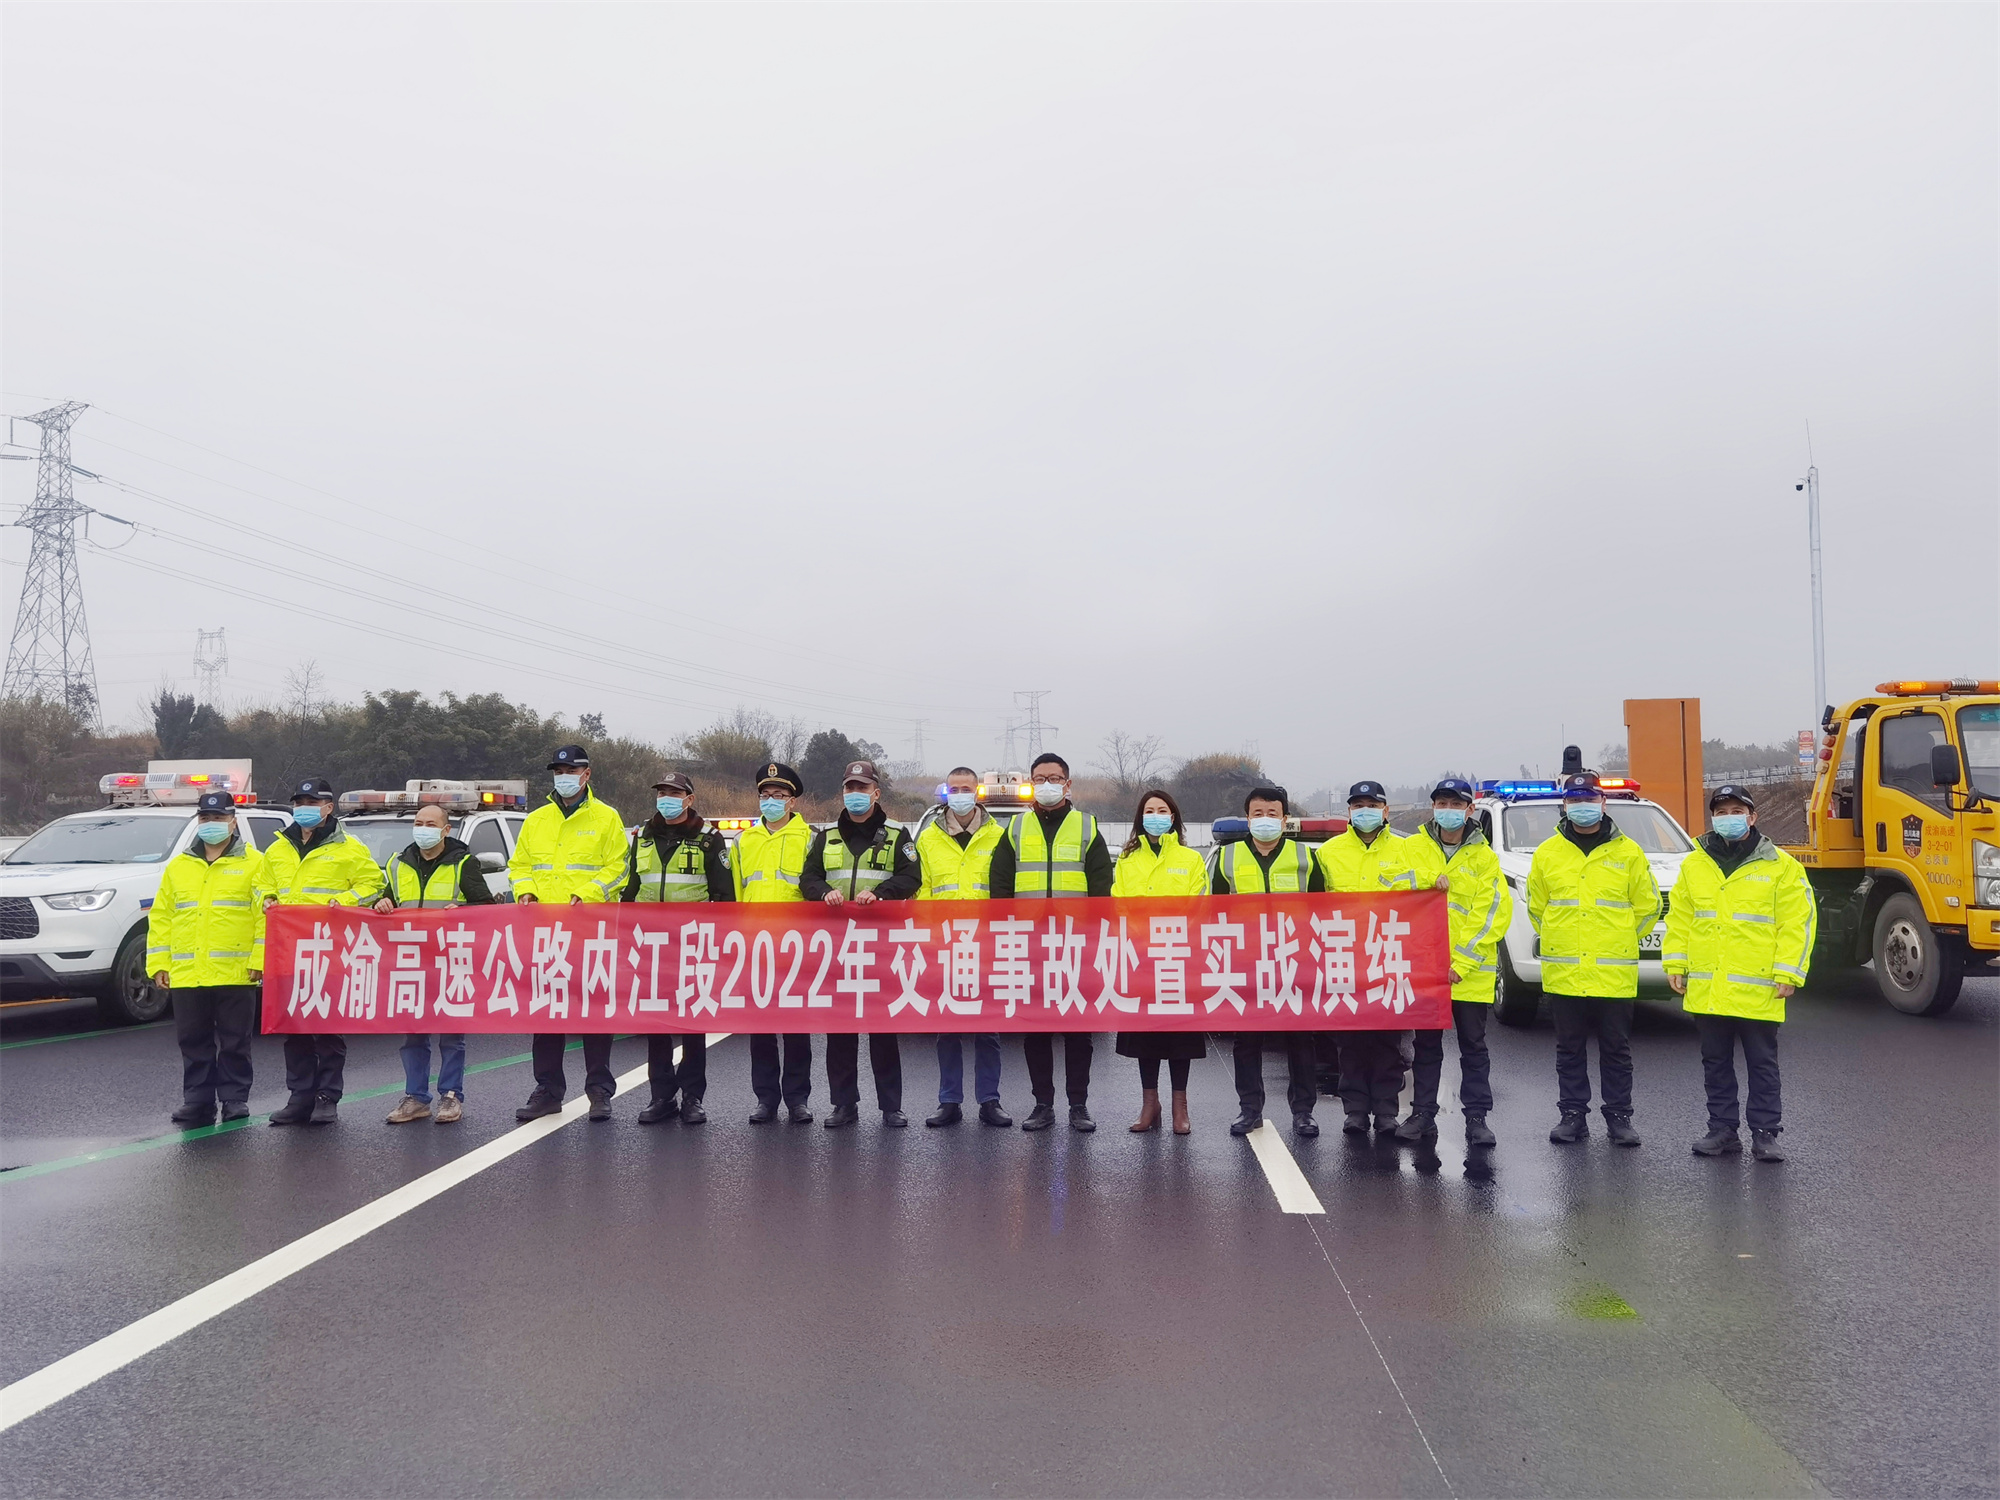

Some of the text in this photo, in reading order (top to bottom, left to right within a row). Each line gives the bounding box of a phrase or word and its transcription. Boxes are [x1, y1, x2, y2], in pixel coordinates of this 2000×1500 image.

[1925, 825, 1955, 837] 成渝高速
[1927, 840, 1953, 852] 3-2-01
[287, 909, 1416, 1020] 成渝高速公路内江段2022年交通事故处置实战演练
